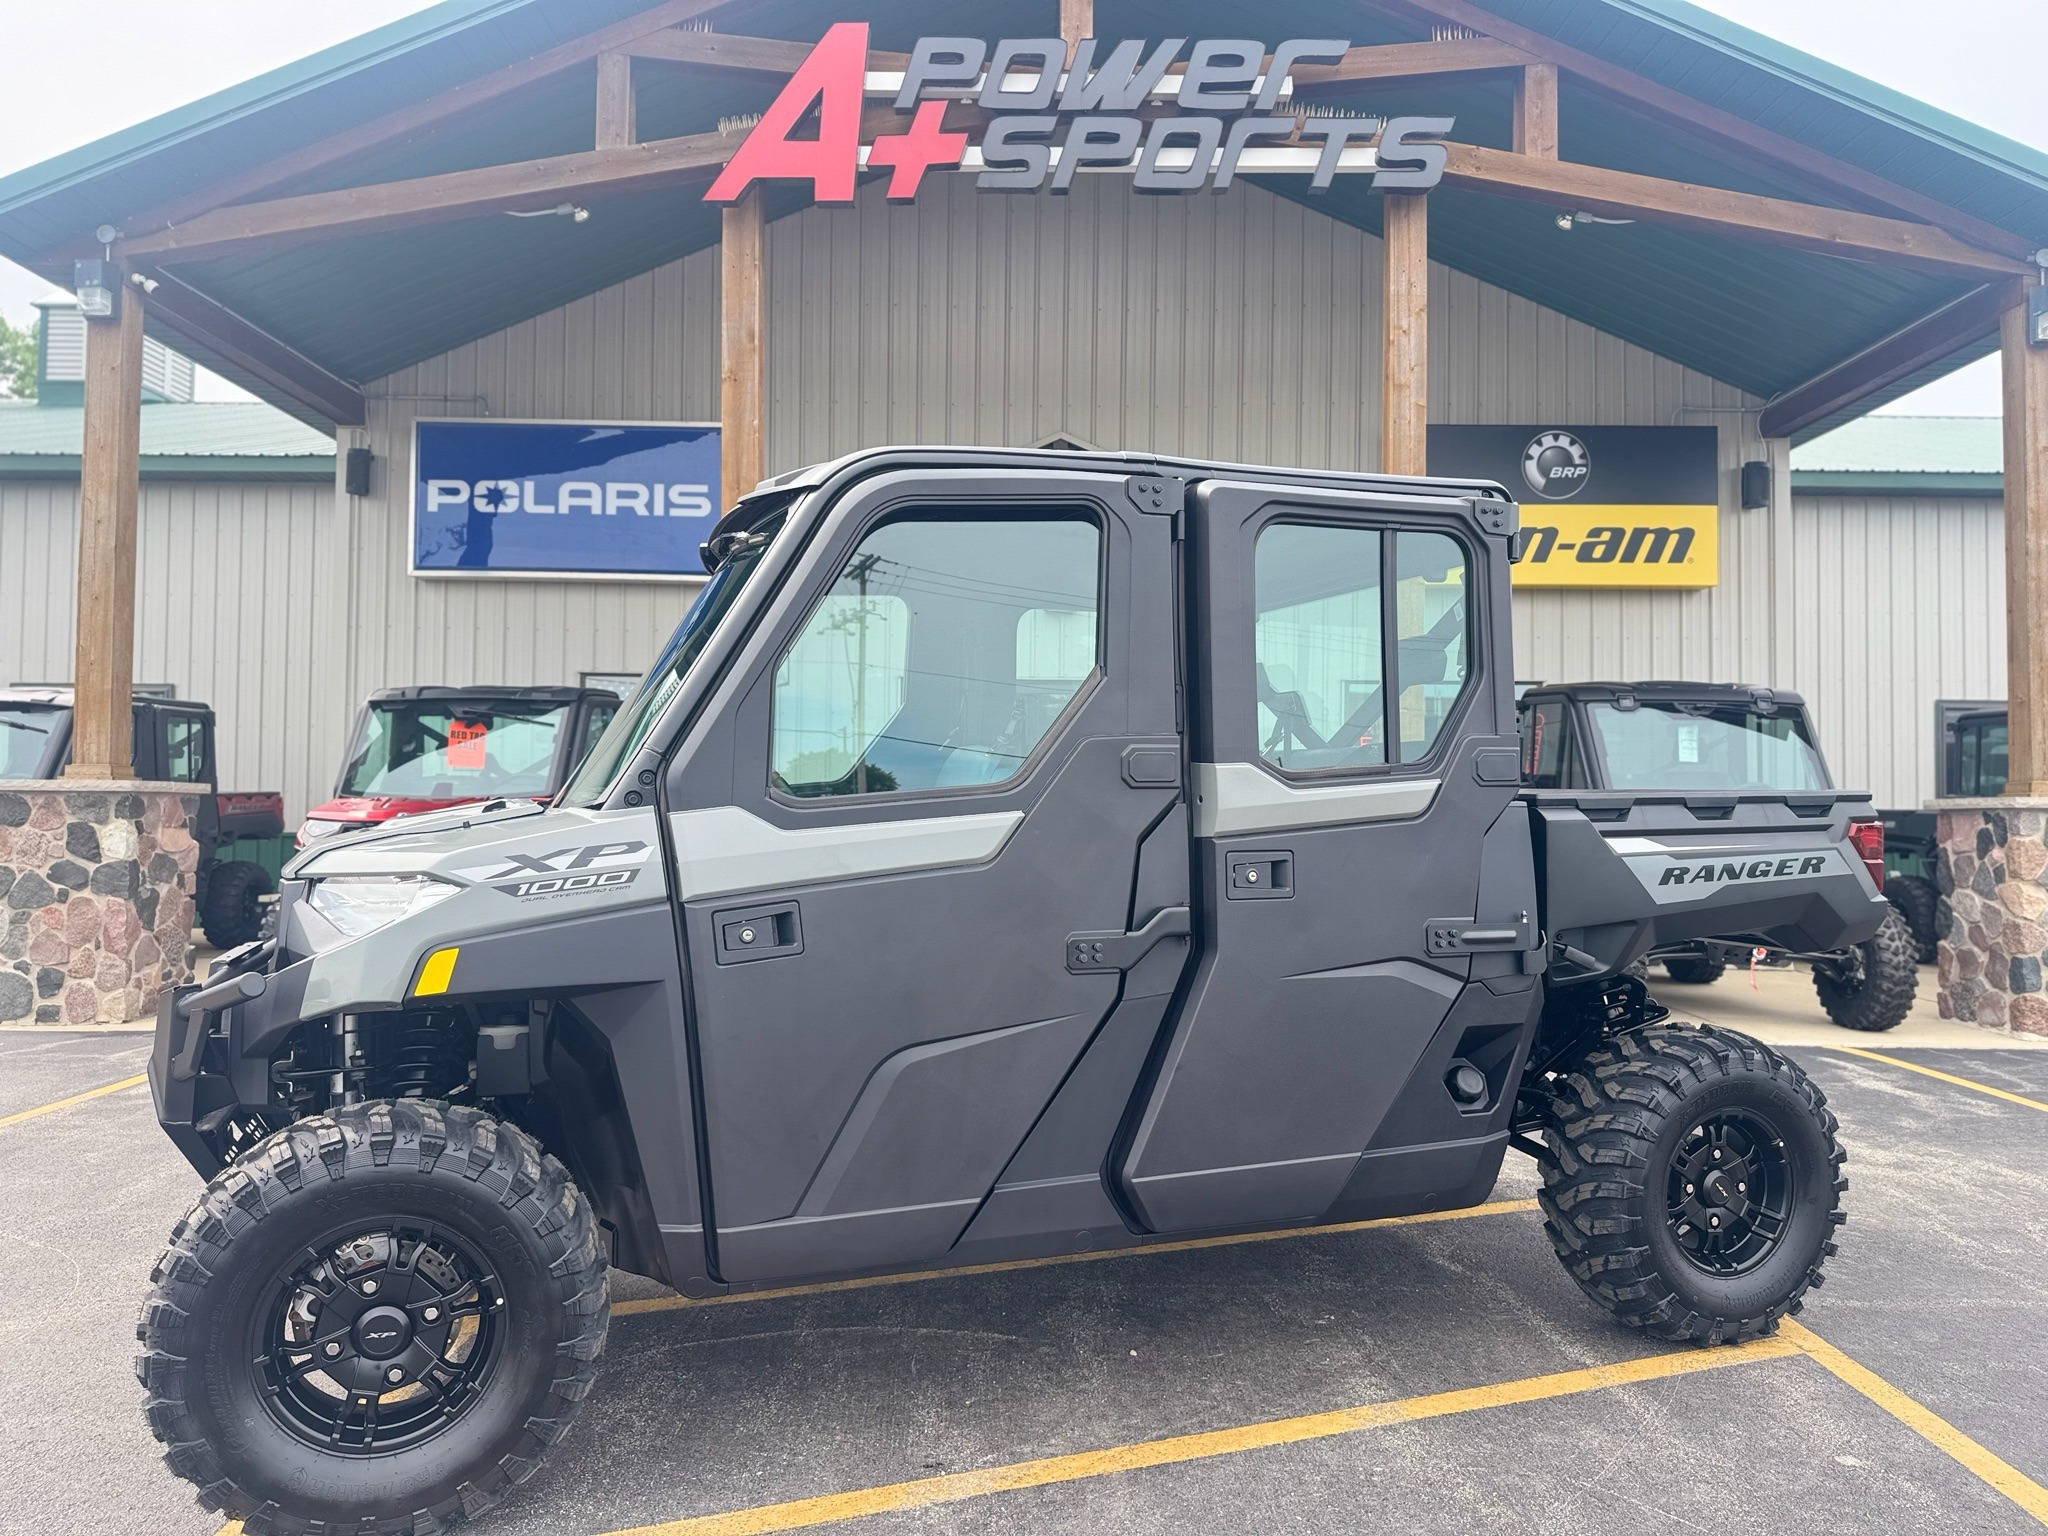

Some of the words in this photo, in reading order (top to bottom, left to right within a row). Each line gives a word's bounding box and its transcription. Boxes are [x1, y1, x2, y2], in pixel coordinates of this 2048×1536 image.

[703, 23, 969, 206] A+
[1549, 466, 1587, 479] BRP
[427, 479, 712, 517] POLARIS
[1519, 526, 1696, 563] n-am
[450, 730, 468, 740] RED
[457, 740, 478, 750] SALE
[483, 840, 648, 881] XP
[1658, 855, 1826, 886] RANGER
[516, 870, 631, 896] 1000
[521, 894, 549, 903] DUAL
[551, 887, 607, 899] OVERHEAD
[608, 884, 631, 892] CAM
[365, 1330, 397, 1340] XP
